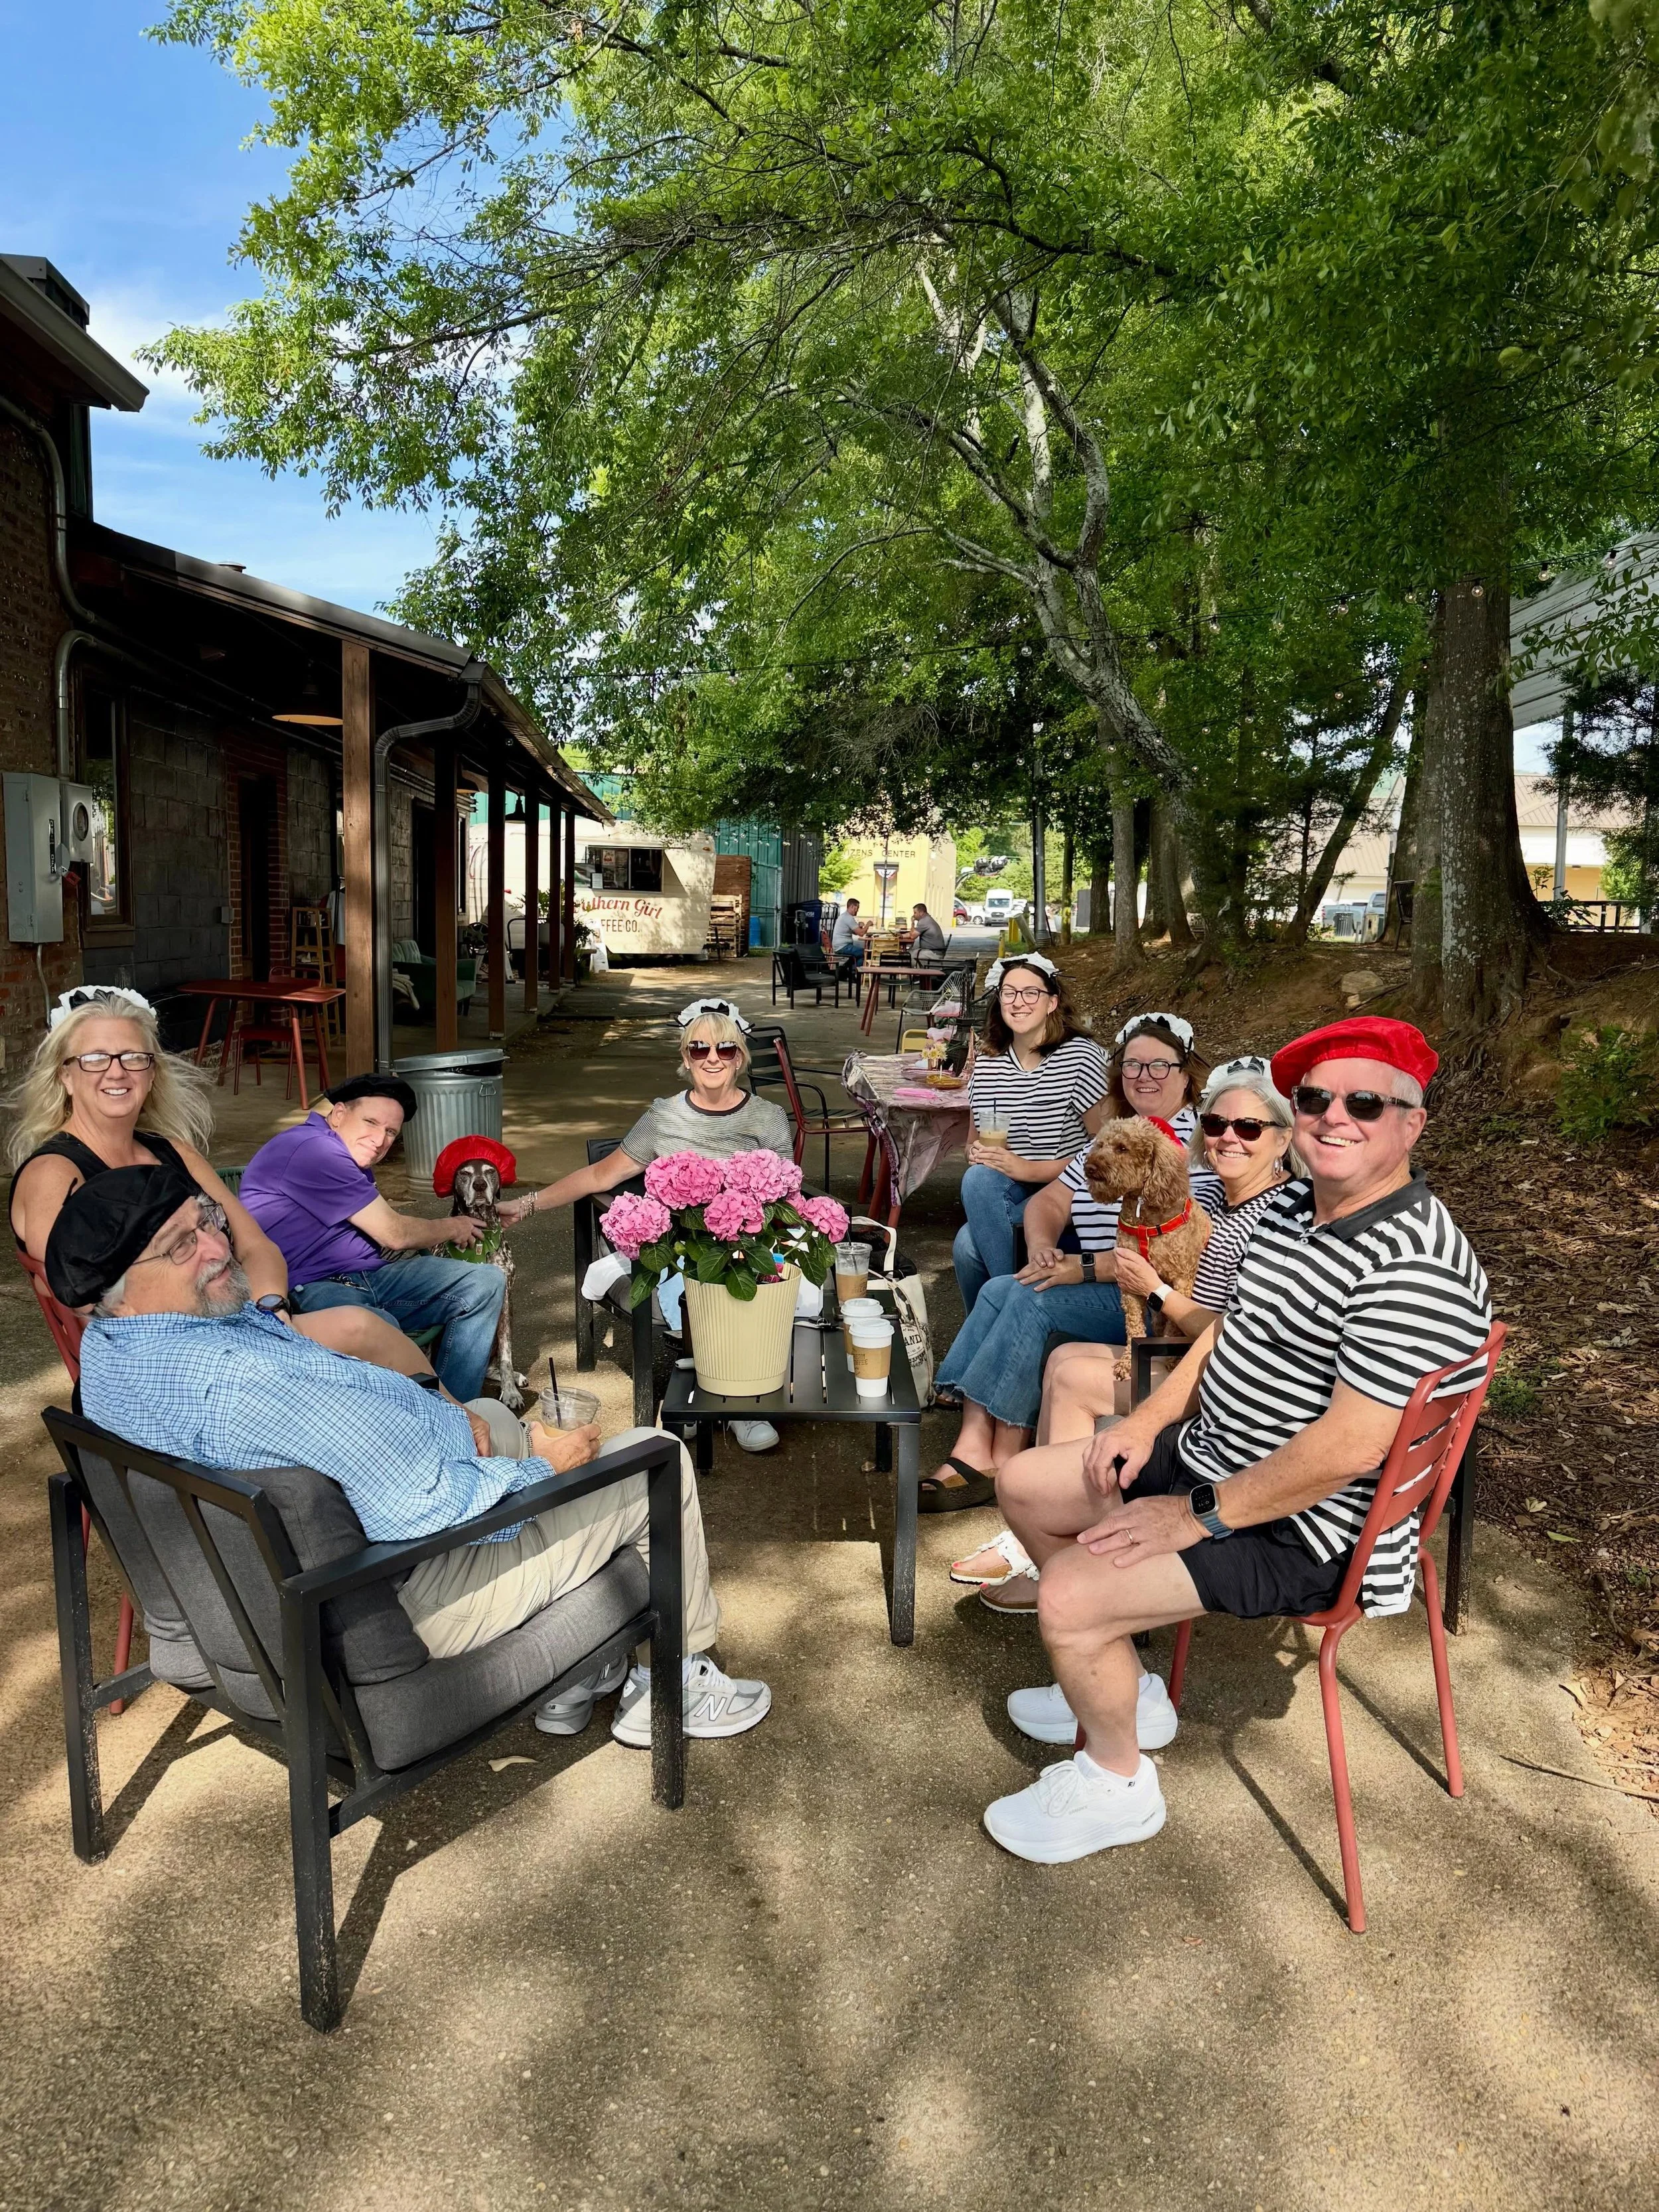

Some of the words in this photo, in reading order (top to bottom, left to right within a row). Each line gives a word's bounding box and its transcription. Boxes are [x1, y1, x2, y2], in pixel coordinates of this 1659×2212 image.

[881, 849, 916, 858] CENTER
[573, 896, 630, 914] uthern
[634, 899, 663, 919] Girl
[601, 919, 623, 932] FFEE
[625, 919, 640, 933] CO.
